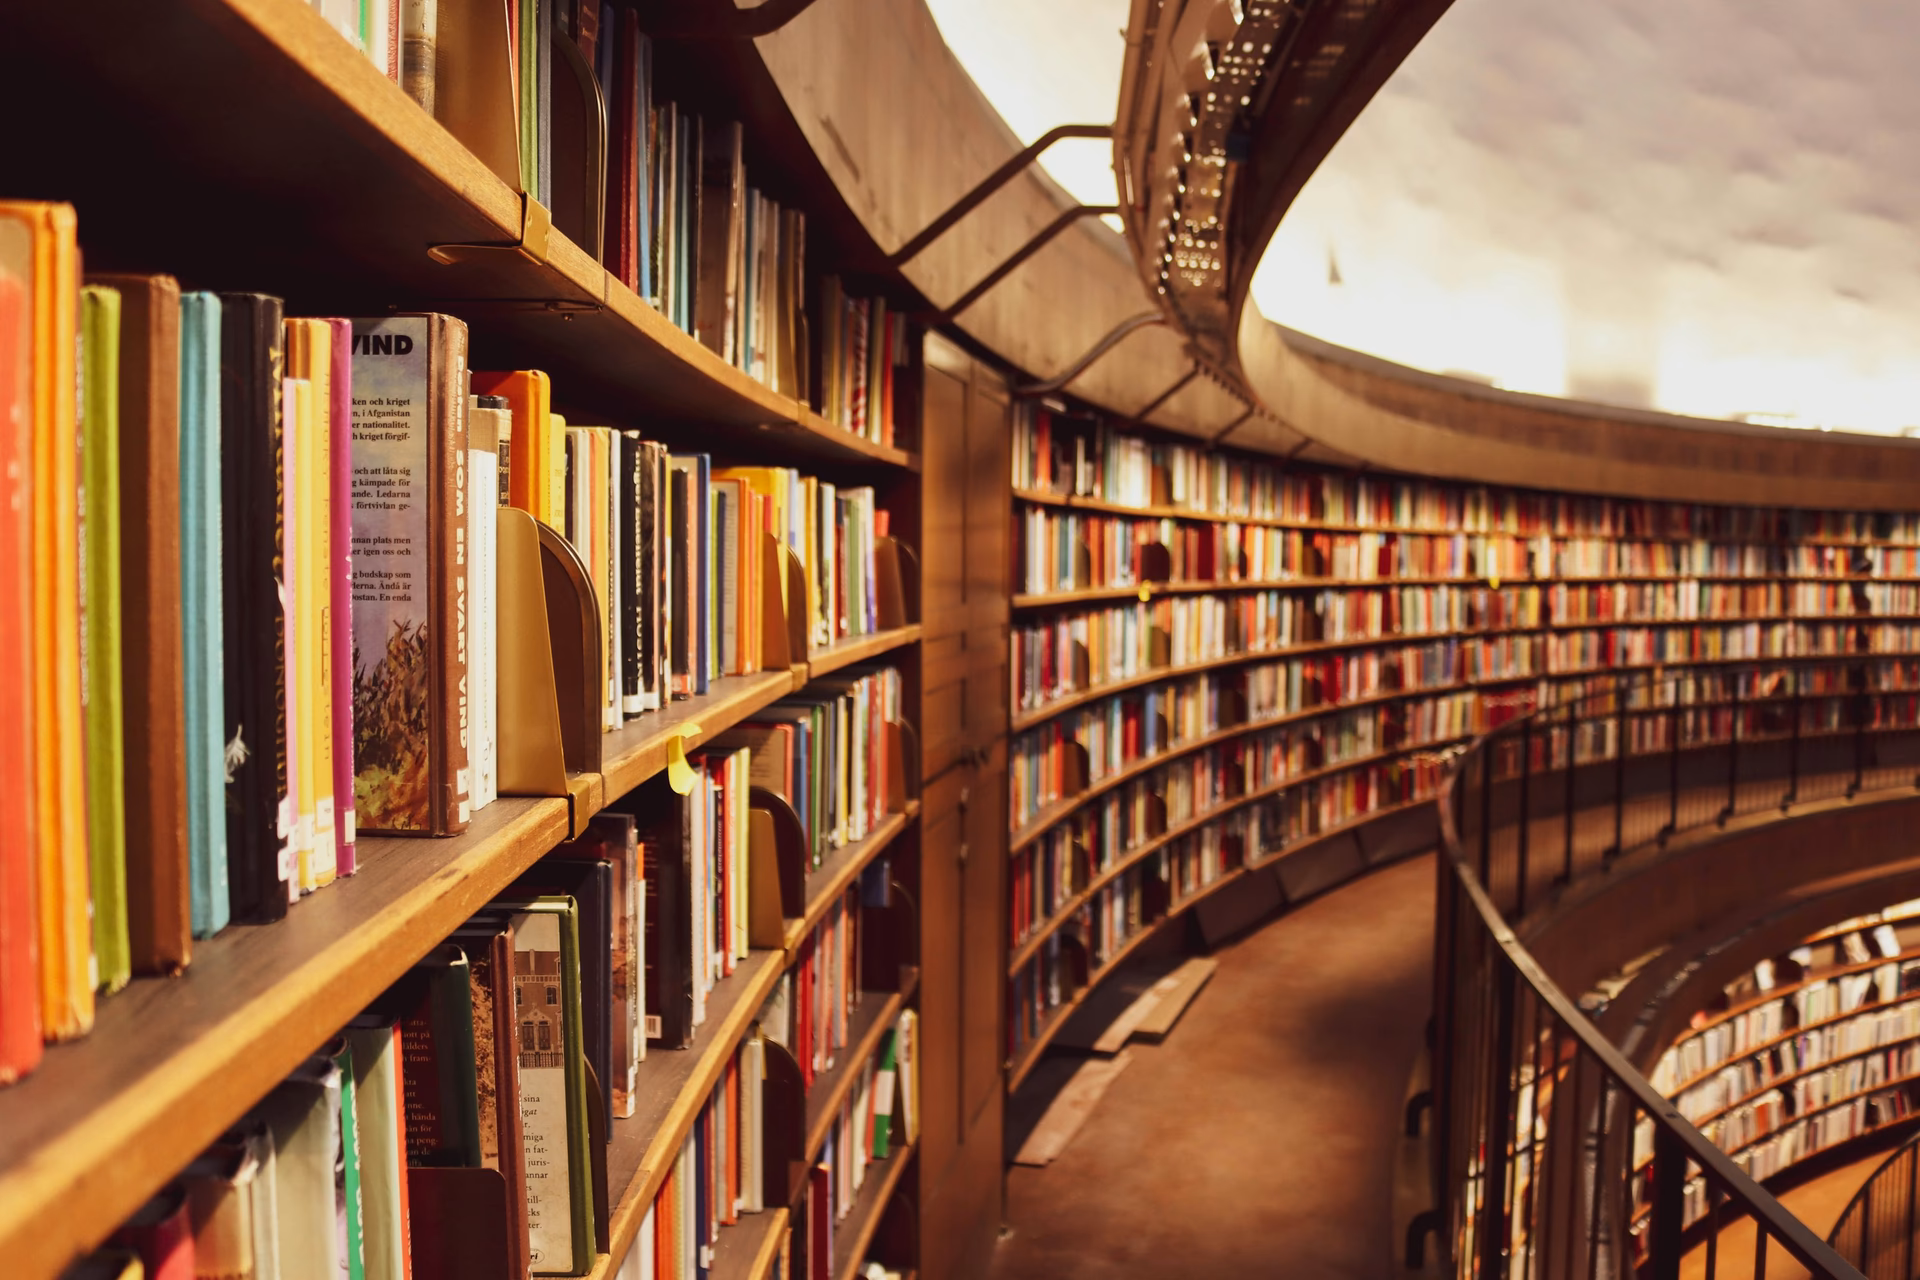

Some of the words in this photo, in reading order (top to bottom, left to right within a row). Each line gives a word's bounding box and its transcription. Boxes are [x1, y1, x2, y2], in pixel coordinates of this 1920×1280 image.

[369, 397, 384, 406] och
[386, 397, 410, 408] kriget
[367, 409, 410, 419] Afganistan
[362, 420, 410, 429] nationalitet.
[359, 432, 383, 442] kriget
[385, 432, 410, 442] förgif-
[354, 467, 369, 475] och
[382, 466, 398, 475] låta
[399, 467, 411, 476] sig
[359, 478, 396, 488] kämpade
[398, 478, 410, 487] för
[456, 449, 464, 516] SOM
[376, 490, 410, 498] Ledarna
[356, 501, 396, 510] förtvivlan
[398, 503, 410, 511] ge-
[373, 535, 392, 546] plats
[456, 528, 464, 565] EN
[363, 547, 381, 557] igen
[396, 547, 411, 555] och
[359, 570, 394, 580] budskap
[378, 579, 400, 590] Ändå
[402, 581, 412, 590] är
[379, 593, 391, 601] En
[392, 593, 412, 601] enda
[457, 576, 465, 665] SVART
[458, 675, 467, 748] VIND
[523, 1094, 541, 1102] sina
[533, 1144, 548, 1154] fat-
[528, 1157, 550, 1168] juris-
